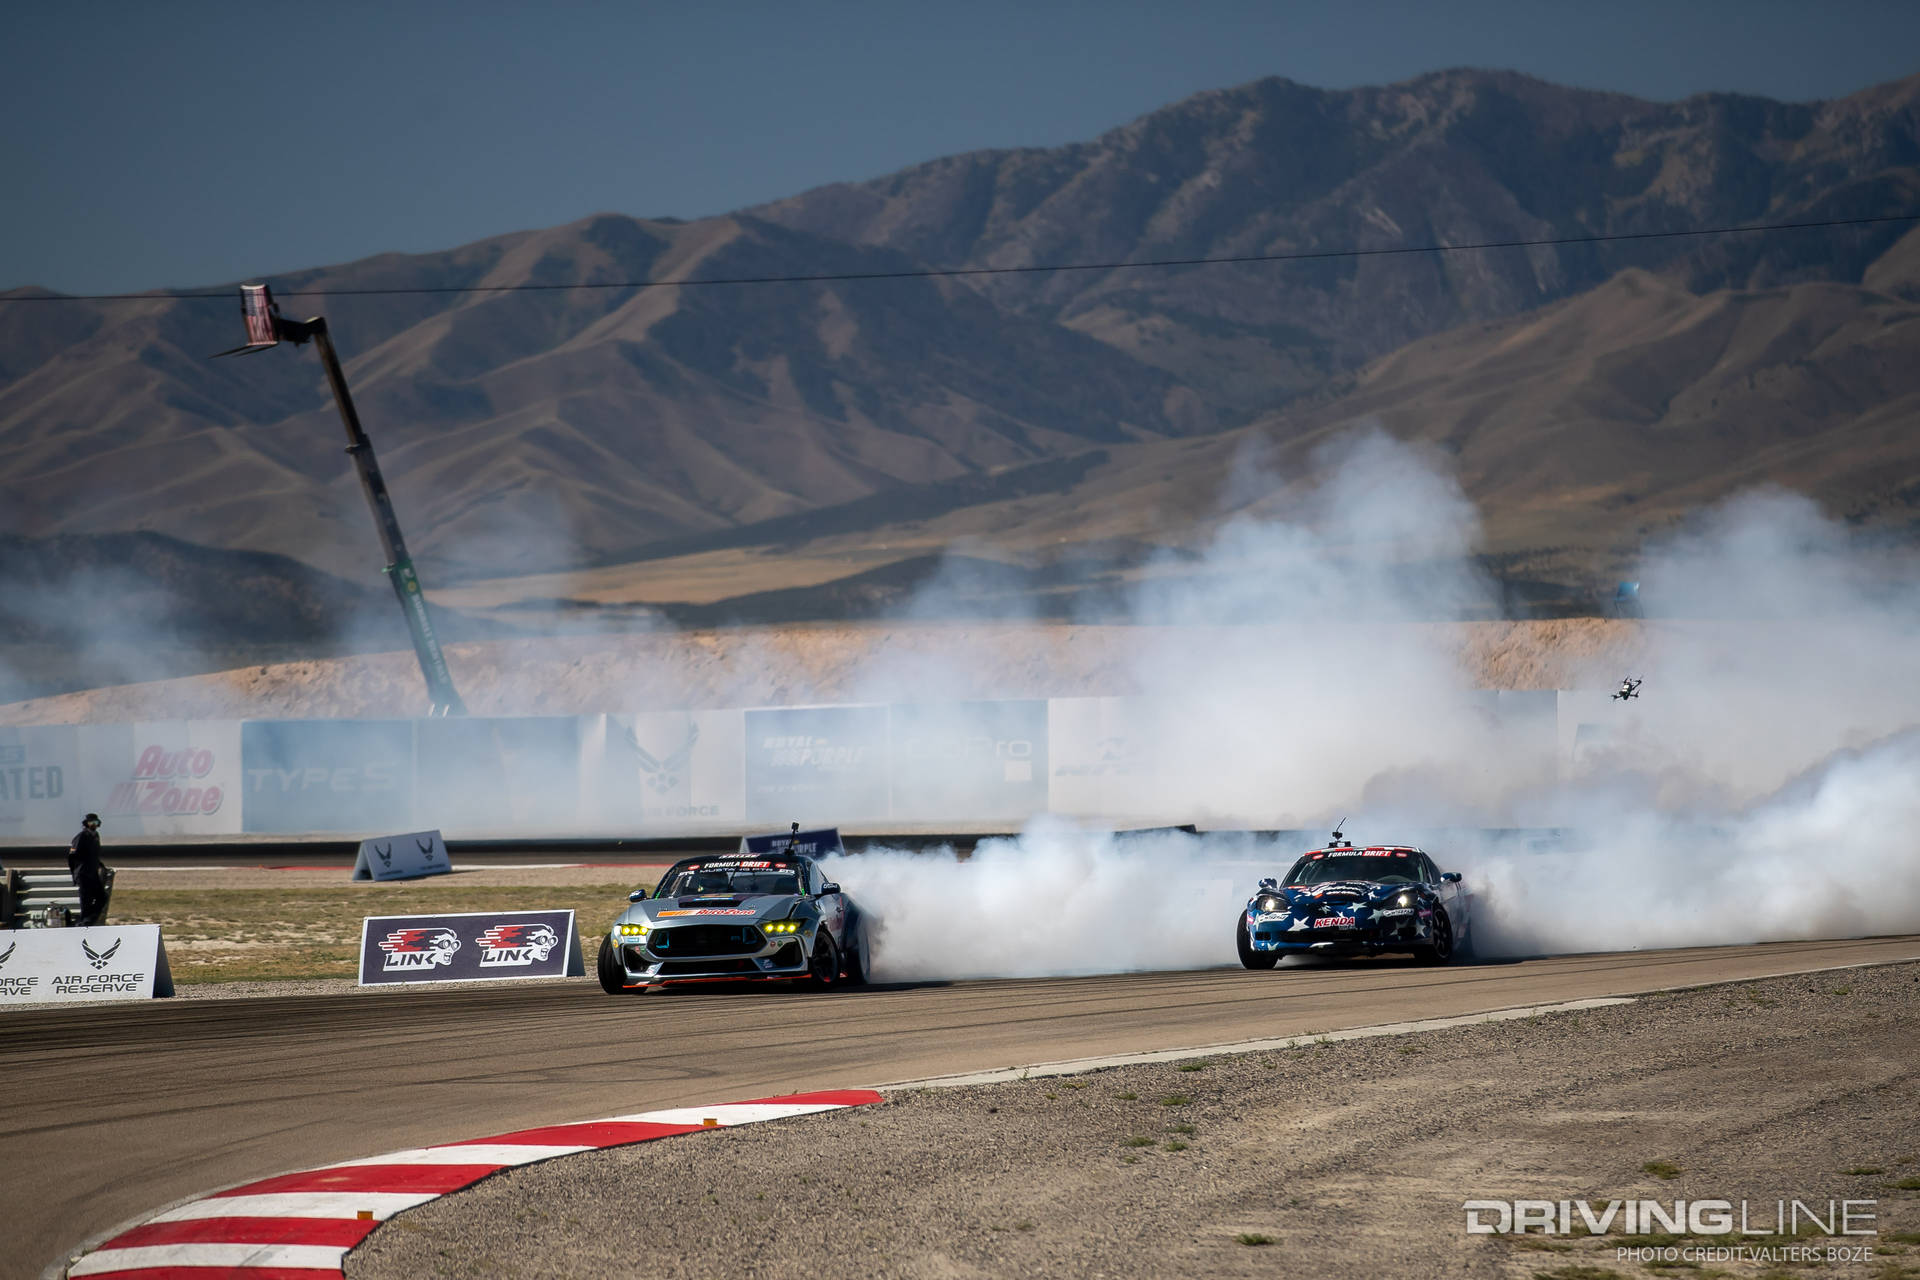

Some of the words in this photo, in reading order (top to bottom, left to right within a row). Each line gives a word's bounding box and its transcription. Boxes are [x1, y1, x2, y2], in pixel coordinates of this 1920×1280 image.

[134, 745, 213, 779] Auto
[139, 781, 223, 814] Zone
[704, 861, 740, 869] FORMULA
[696, 908, 756, 916] AutoZone
[1313, 917, 1356, 928] KENDA
[385, 952, 437, 967] LINK
[482, 949, 535, 963] LINK
[51, 975, 82, 985] AIR
[86, 973, 145, 984] FORCE
[55, 983, 138, 994] RESERVE
